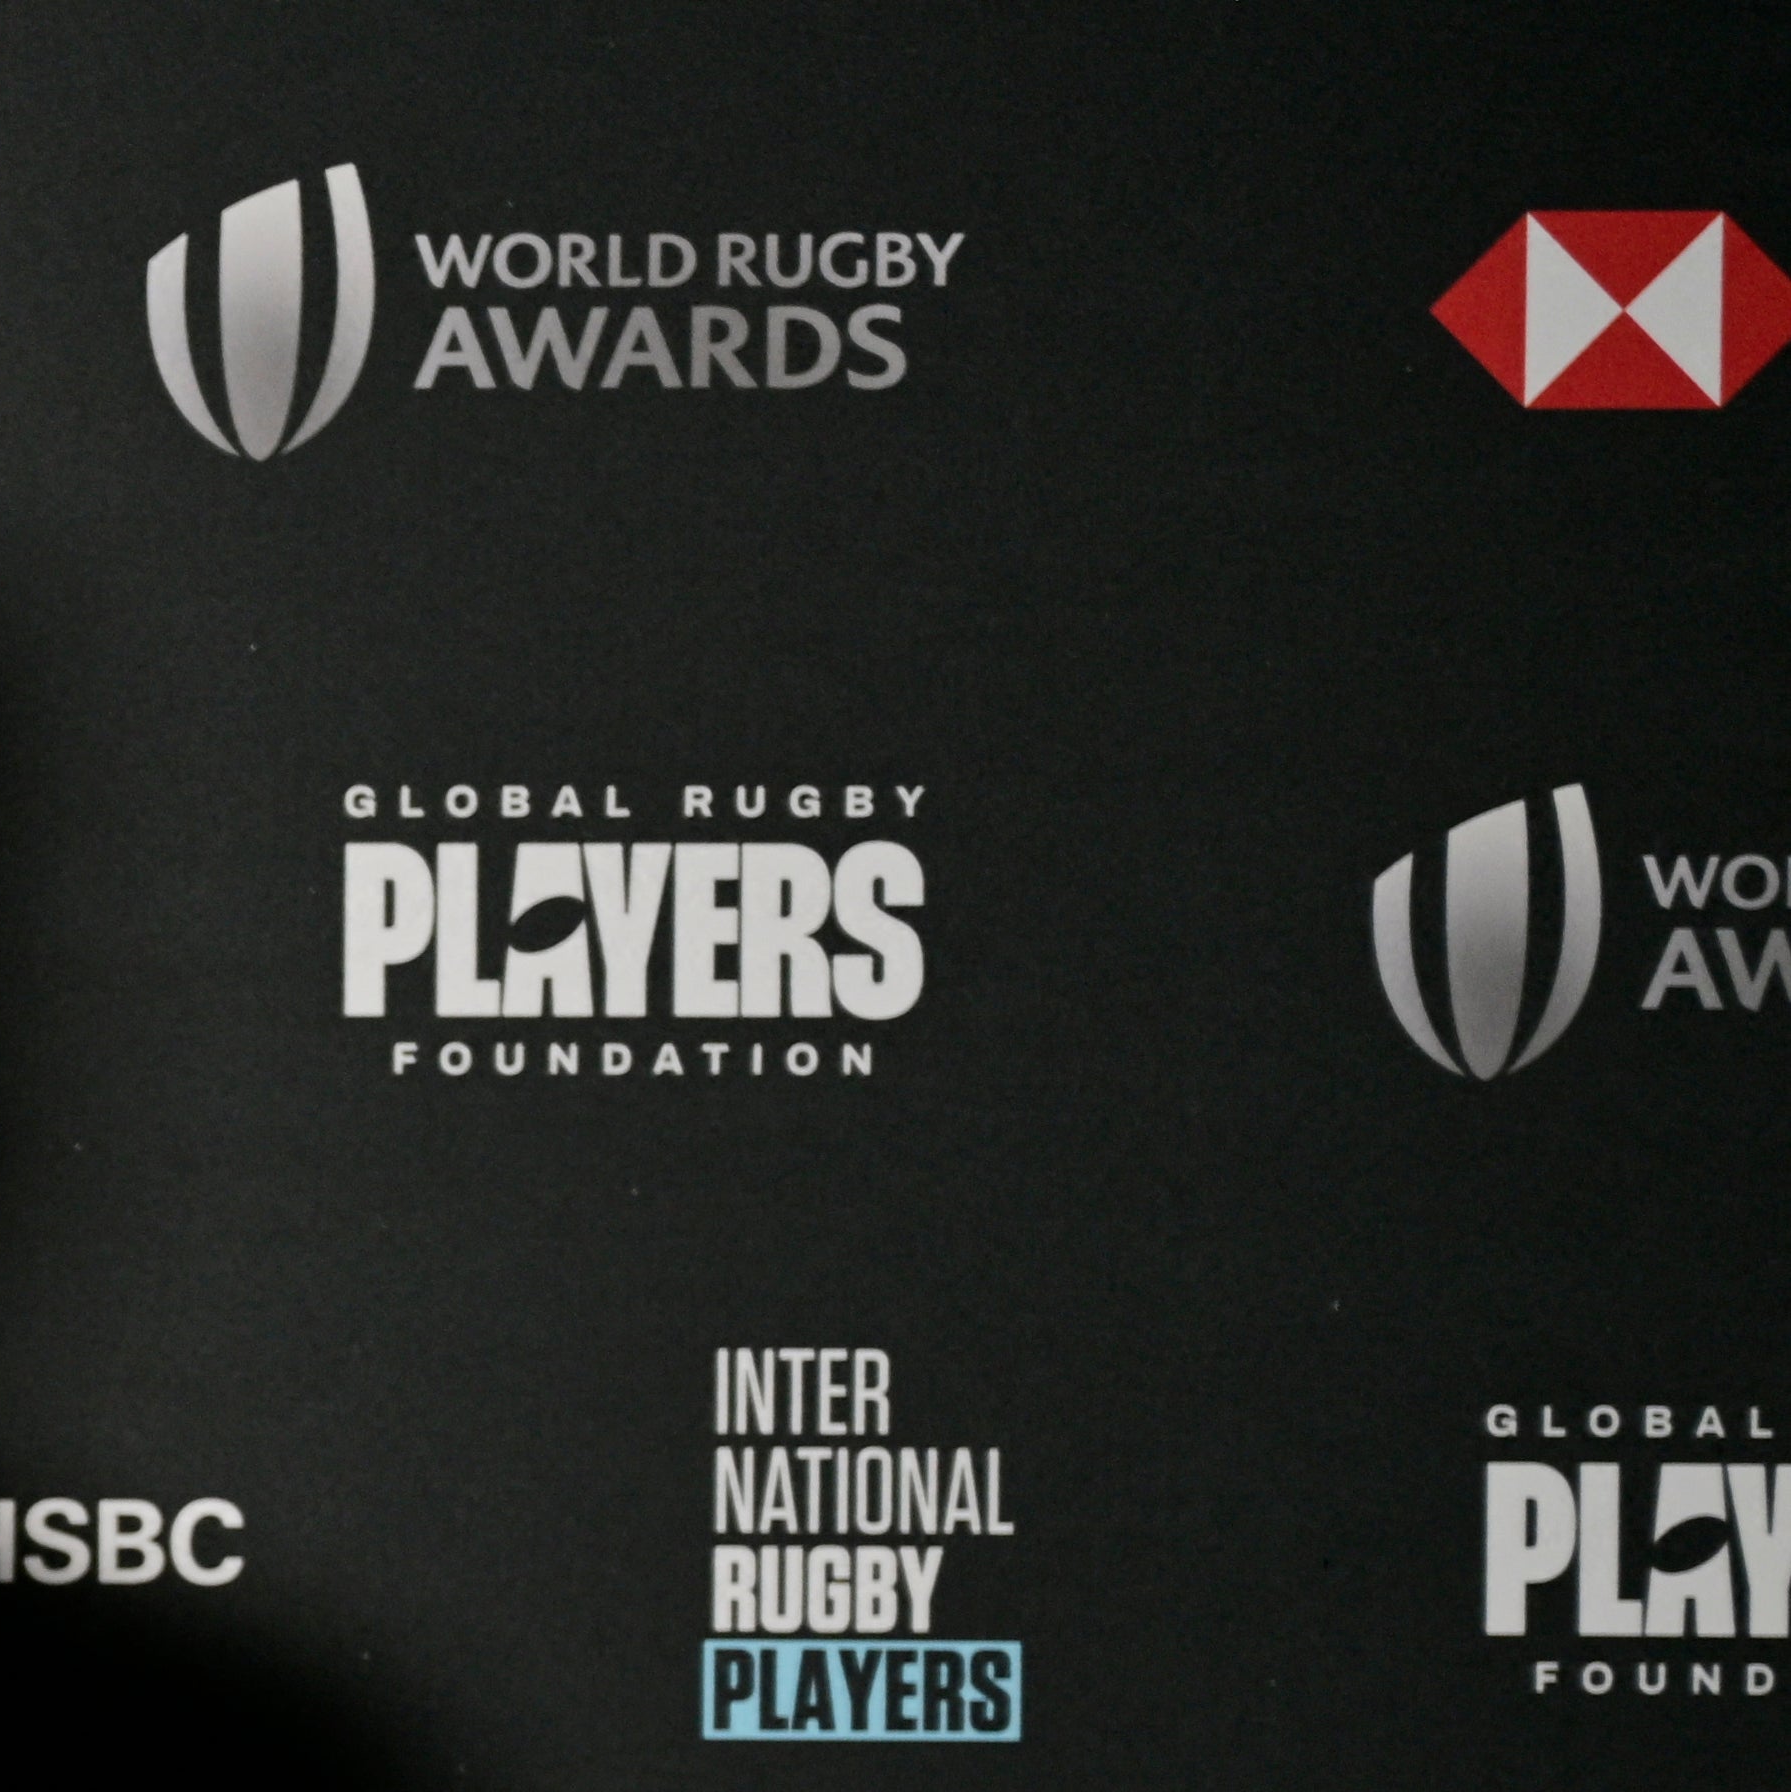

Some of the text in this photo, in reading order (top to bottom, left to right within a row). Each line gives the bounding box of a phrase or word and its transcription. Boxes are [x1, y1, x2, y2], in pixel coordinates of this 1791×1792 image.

[415, 232, 964, 288] WORLD RUGBY
[414, 304, 906, 389] AWARDS
[344, 785, 924, 818] GLOBAL RUGBY
[343, 841, 924, 1020] PLAYERS
[393, 1042, 871, 1076] FOUNDATION
[716, 1348, 889, 1435] INTER
[1485, 1404, 1772, 1438] GLOBAL
[715, 1447, 1014, 1535] NATIONAL
[713, 1545, 943, 1633] RUGBY
[714, 1649, 1011, 1733] PLAYERS
[1535, 1661, 1774, 1695] FOUND
